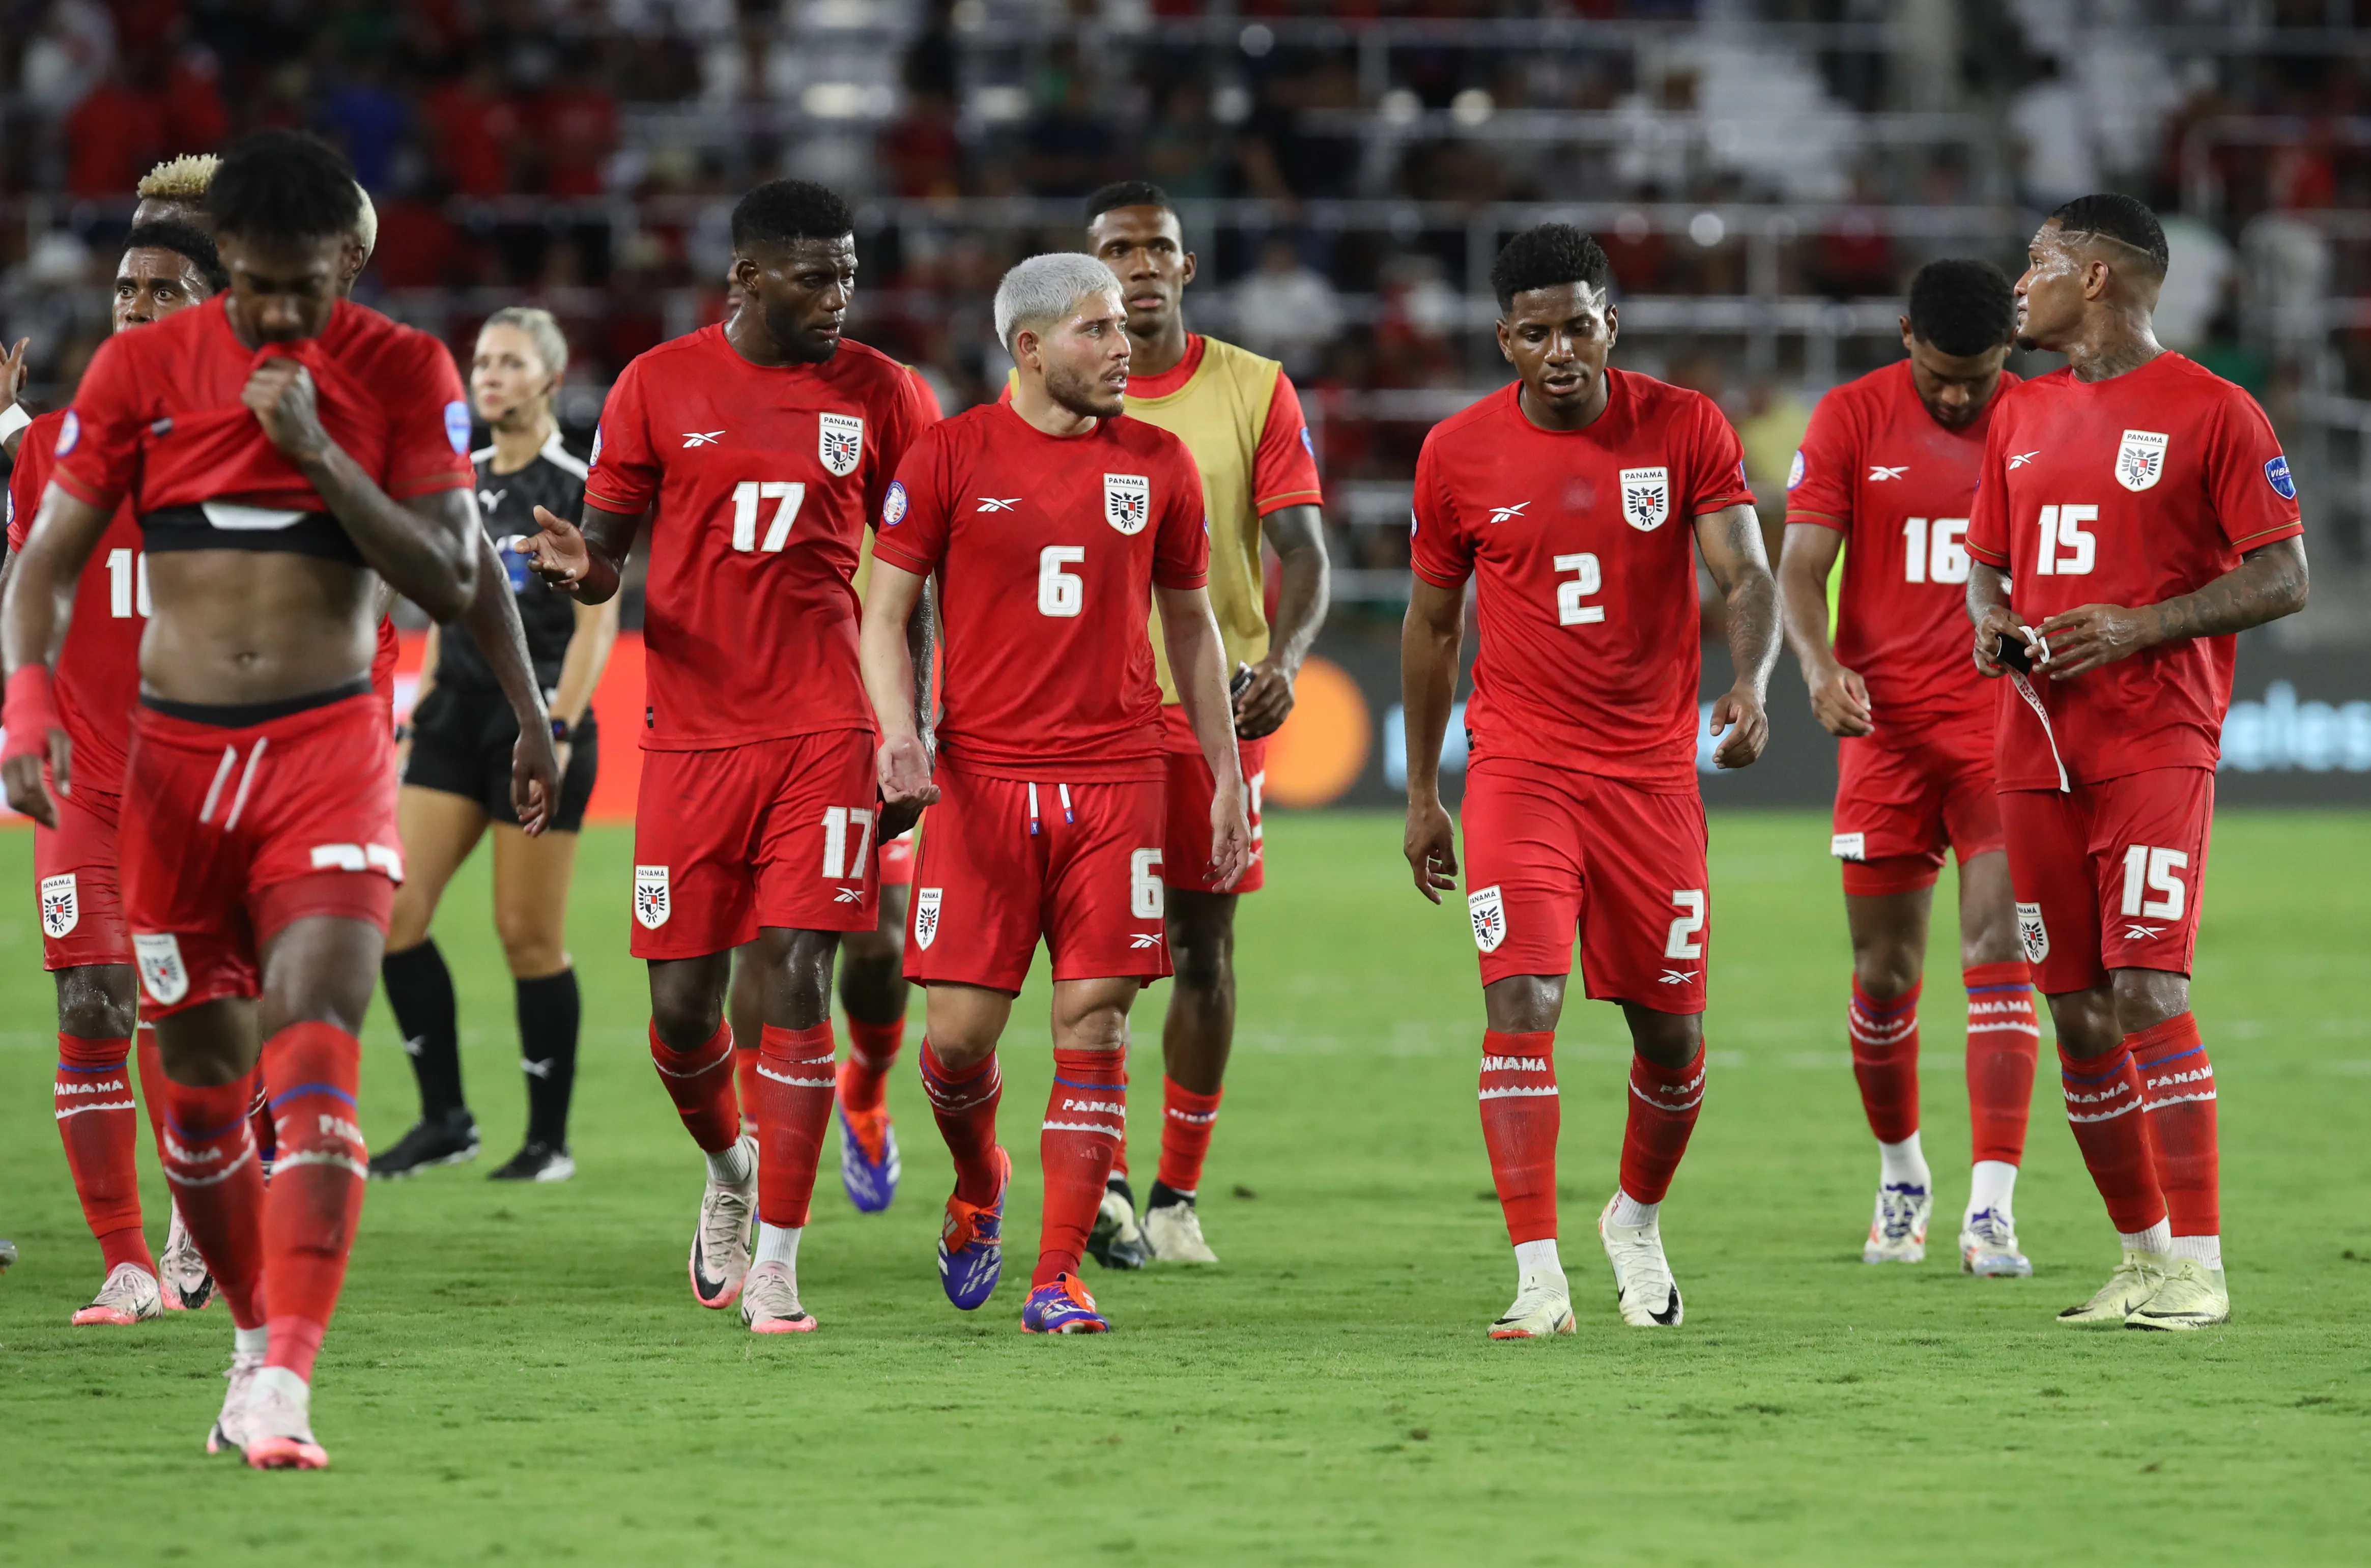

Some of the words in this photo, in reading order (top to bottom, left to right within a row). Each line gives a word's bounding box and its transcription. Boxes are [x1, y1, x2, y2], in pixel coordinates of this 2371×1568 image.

[824, 417, 859, 427] PANAMÁ
[2127, 434, 2162, 443] PANAMÁ
[1108, 477, 1144, 486] PANAMÁ
[1625, 470, 1663, 479] PANAMÁ
[731, 481, 806, 553] 17
[1903, 517, 1971, 584] 16
[2036, 504, 2099, 575] 15
[105, 548, 152, 618] 1
[1037, 546, 1084, 617] 6
[1553, 552, 1605, 626] 2
[820, 806, 874, 879] 17
[43, 877, 71, 889] PANAMÁ
[1130, 847, 1163, 919] 6
[1470, 890, 1496, 905] PANAMÁ
[2121, 844, 2189, 921] 15
[1664, 889, 1705, 960] 2
[2147, 1063, 2213, 1090] PANAM
